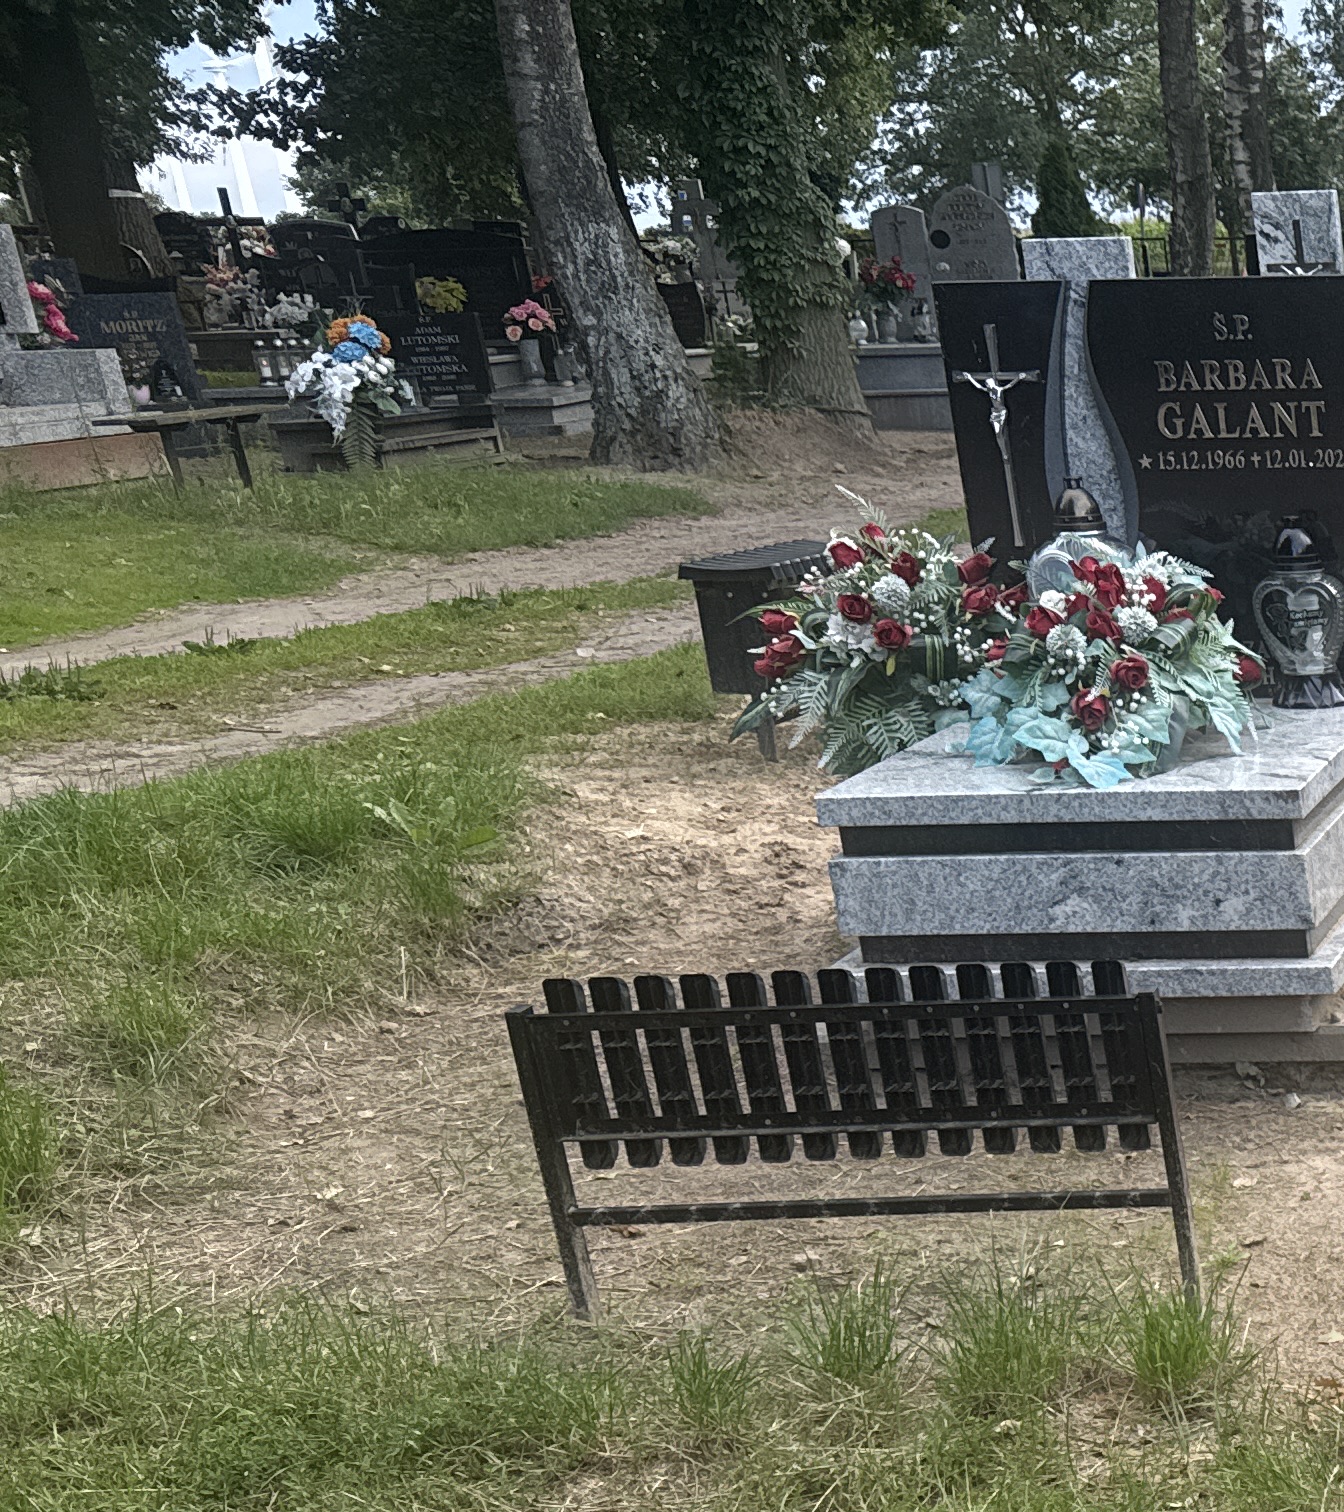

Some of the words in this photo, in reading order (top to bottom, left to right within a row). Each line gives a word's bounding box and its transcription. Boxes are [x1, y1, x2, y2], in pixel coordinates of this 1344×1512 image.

[100, 319, 168, 335] MORITZ
[415, 326, 442, 335] ADAM
[1213, 310, 1254, 341] Ś.P.
[400, 335, 461, 346] LUTOMSKI
[1153, 357, 1323, 392] BARBARA
[1157, 400, 1326, 440] GALANT
[1157, 449, 1246, 471] 15.12.1966
